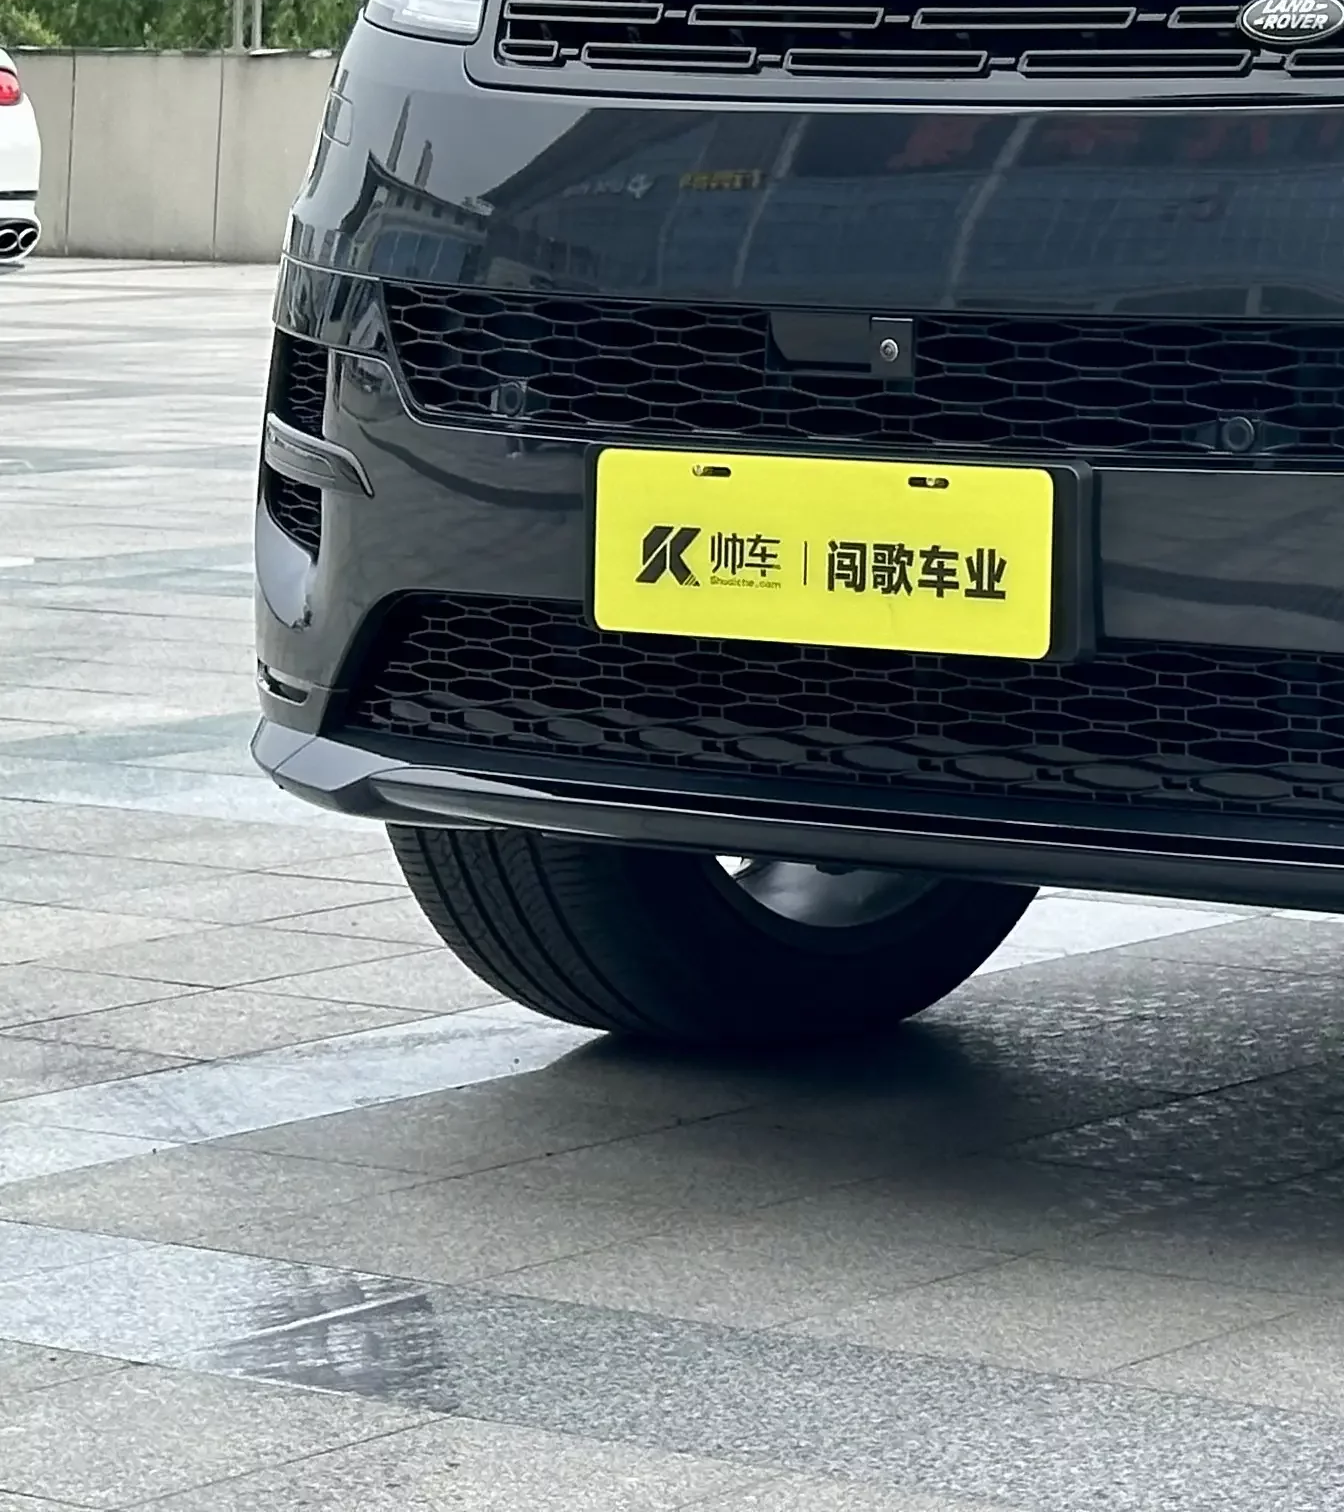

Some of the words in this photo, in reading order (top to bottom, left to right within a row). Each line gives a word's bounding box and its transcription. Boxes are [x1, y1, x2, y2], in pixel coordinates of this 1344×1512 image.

[1262, 13, 1329, 30] ROVER
[710, 531, 781, 577] 帅车
[826, 539, 1007, 601] 闯歌车业
